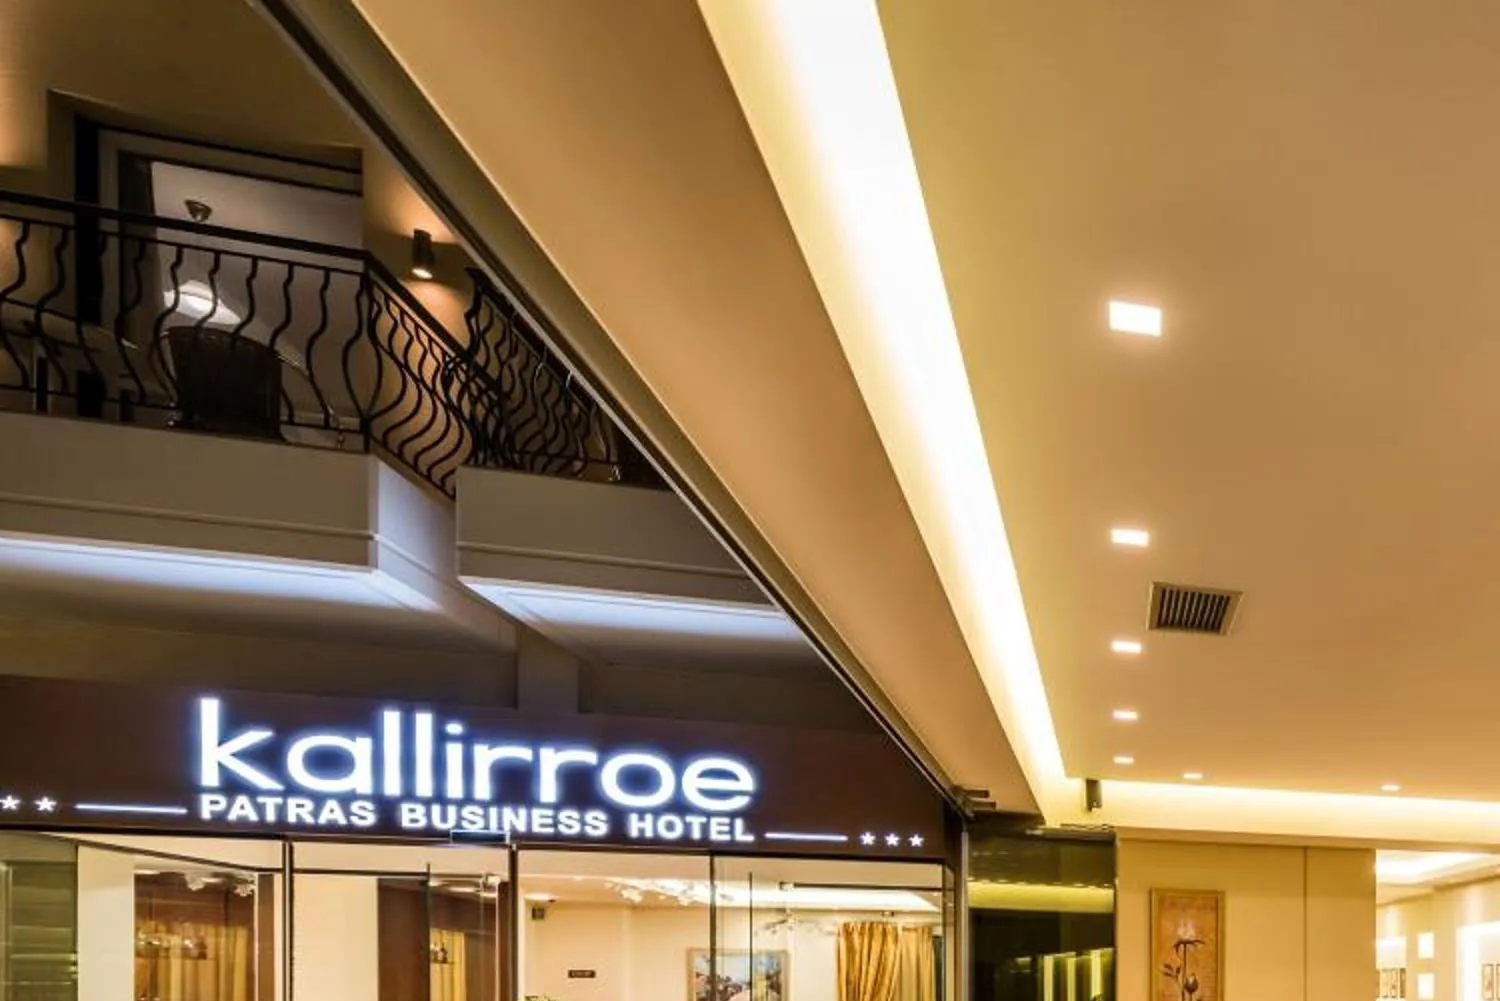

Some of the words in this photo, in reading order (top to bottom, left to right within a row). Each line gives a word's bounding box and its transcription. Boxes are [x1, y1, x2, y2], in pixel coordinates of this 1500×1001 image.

[199, 697, 755, 811] kallirroe
[200, 792, 376, 826] PATRAS
[399, 802, 610, 837] BUSINESS
[628, 812, 755, 842] HOTEL
